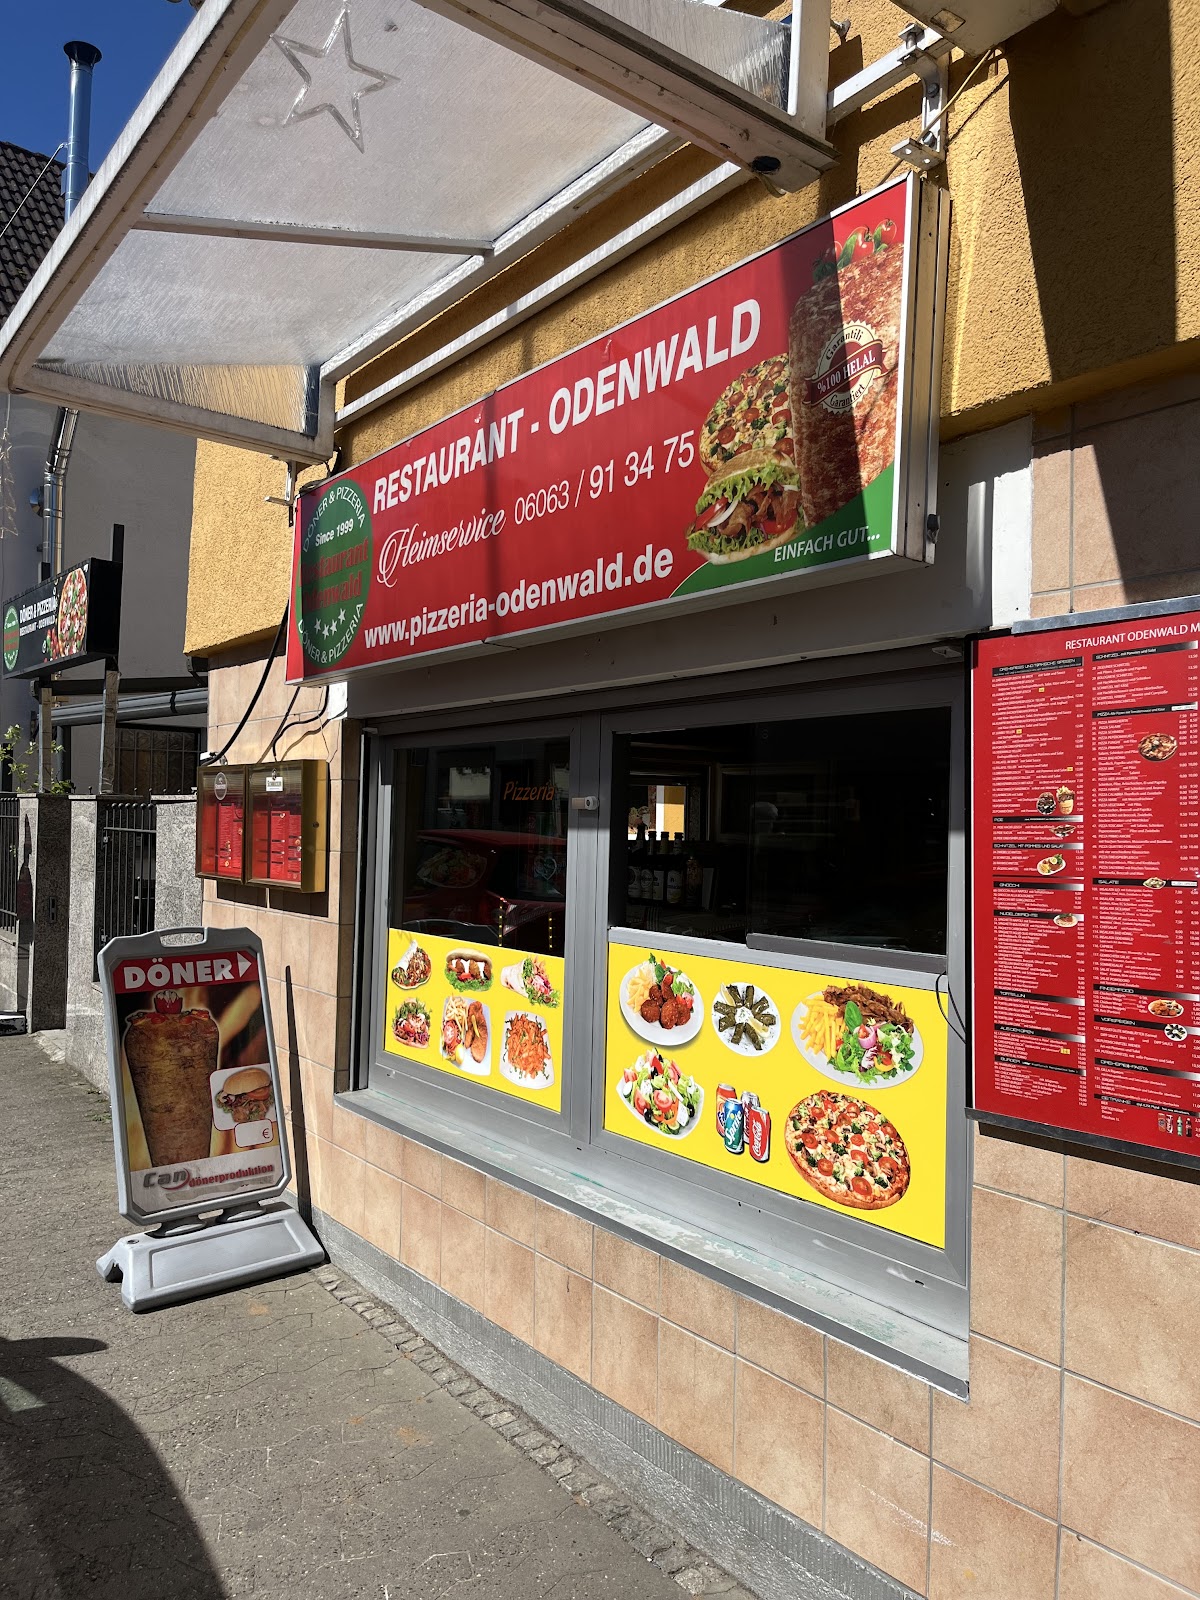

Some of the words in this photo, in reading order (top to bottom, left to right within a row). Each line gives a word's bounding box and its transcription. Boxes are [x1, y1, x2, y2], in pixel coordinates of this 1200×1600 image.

[826, 328, 864, 360] Garantili
[817, 371, 841, 394] %100
[843, 350, 876, 378] HELAL
[373, 408, 524, 514] RESTAURANT
[548, 298, 761, 434] ODENWALD
[830, 384, 865, 407] Garantiert
[302, 497, 328, 553] DÖNER
[329, 490, 335, 503] &
[336, 486, 366, 529] PIZZERIA
[377, 507, 506, 588] Heimservice
[514, 481, 570, 525] 06063
[574, 469, 585, 507] /
[589, 464, 615, 499] 91
[624, 445, 654, 486] 34
[663, 430, 696, 473] 75
[315, 529, 334, 547] Since
[336, 518, 354, 536] 1999
[774, 529, 833, 564] EINFACH
[20, 604, 33, 623] DÖNER
[37, 596, 57, 616] PIZZERIA
[364, 543, 674, 649] www.pizzeria-odenwald.de
[321, 650, 328, 664] &
[329, 602, 364, 663] PIZZERIA
[1065, 632, 1126, 650] RESTAURANT
[1127, 625, 1188, 642] ODENWALD
[503, 781, 556, 801] Pizzeria
[124, 957, 234, 990] DÖNER
[725, 1110, 743, 1145] Sprite
[143, 1168, 188, 1189] Can
[188, 1163, 275, 1189] dönerproduktion
